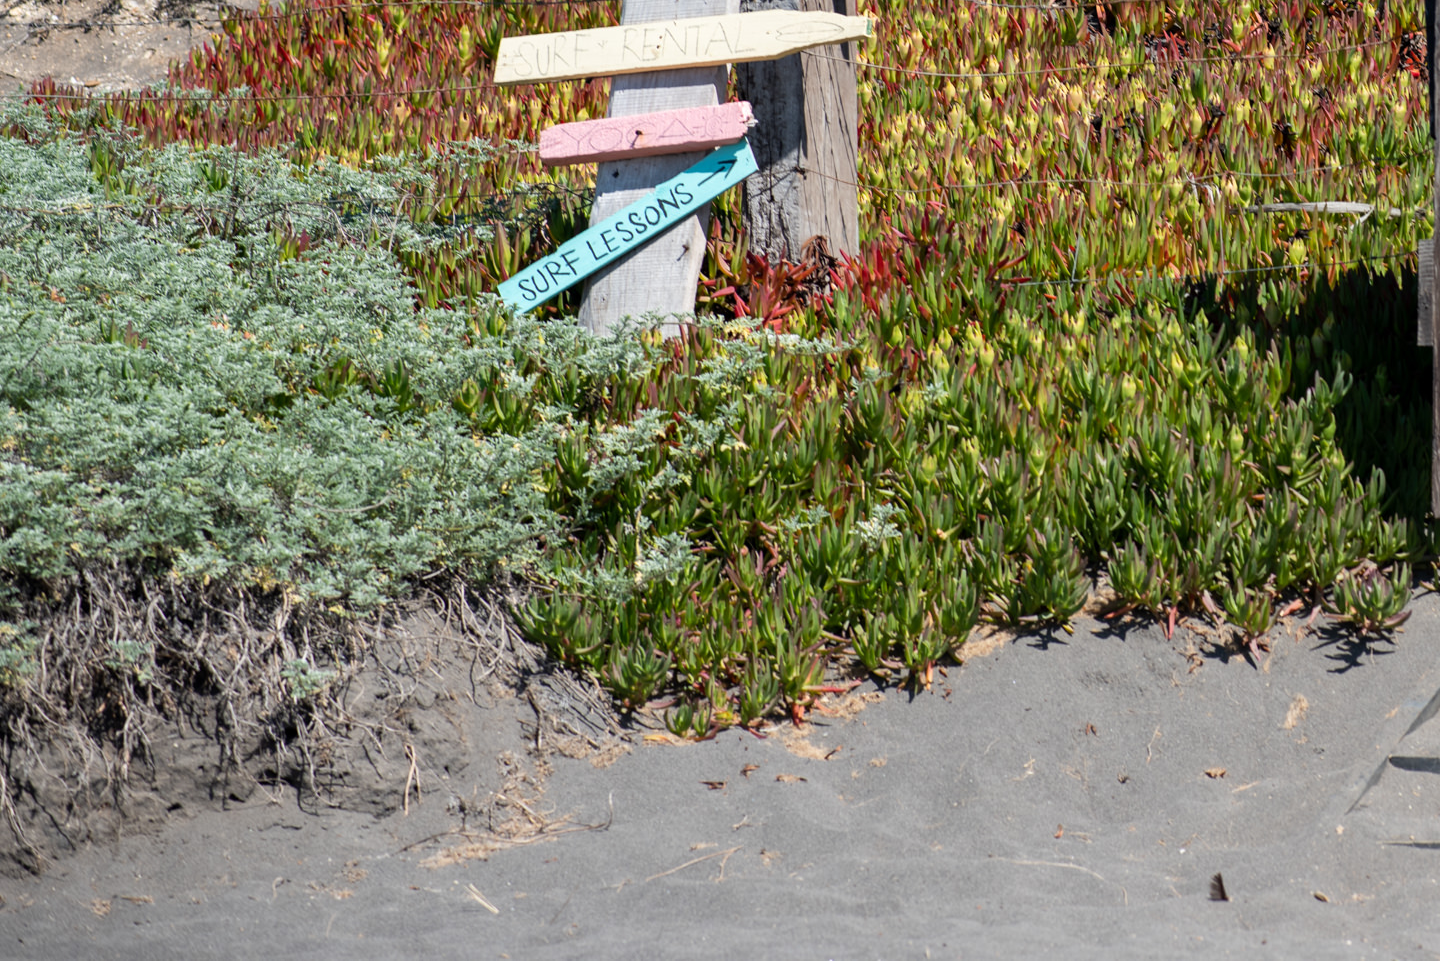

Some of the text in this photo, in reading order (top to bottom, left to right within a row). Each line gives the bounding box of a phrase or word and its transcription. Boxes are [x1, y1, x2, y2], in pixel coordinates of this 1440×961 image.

[514, 20, 756, 77] SURF RENTAL
[560, 118, 695, 153] YOGA
[518, 183, 694, 301] SURF LESSONS
